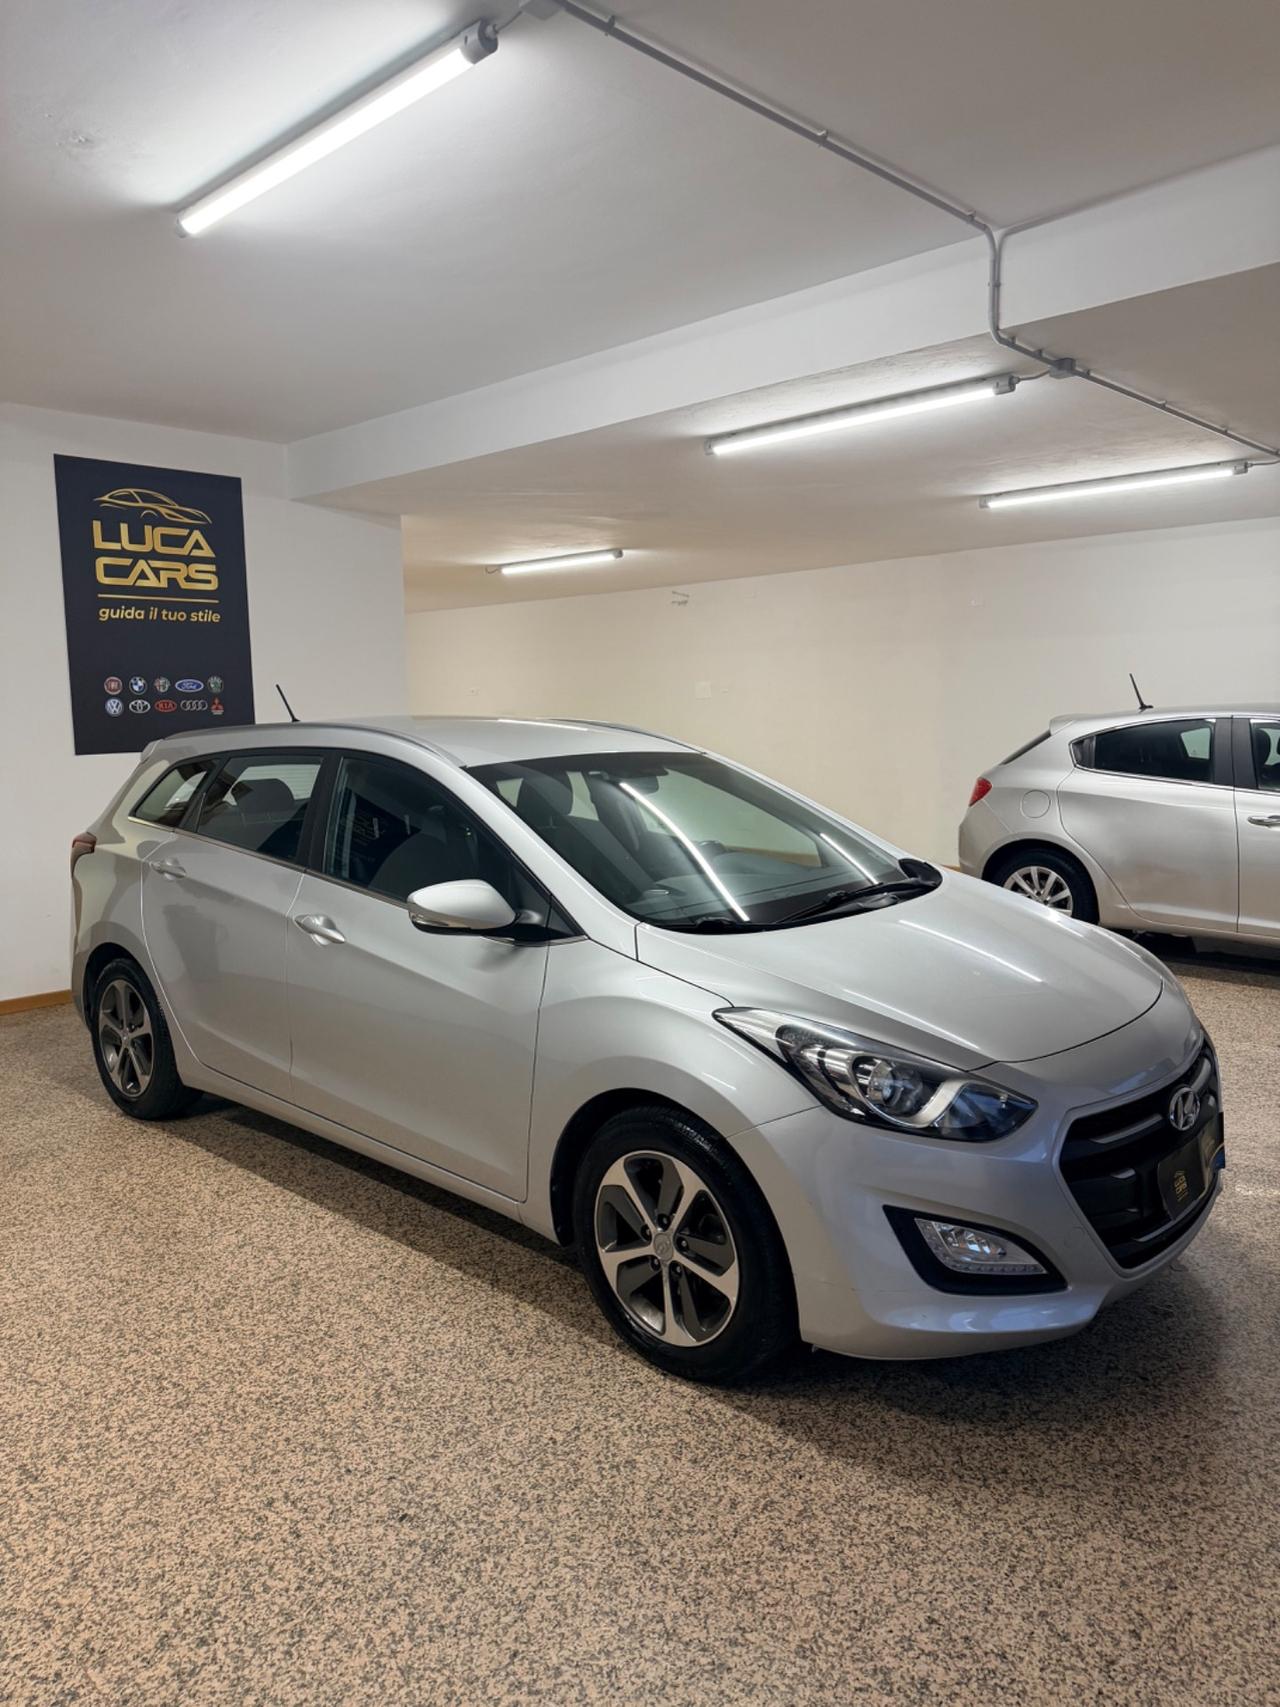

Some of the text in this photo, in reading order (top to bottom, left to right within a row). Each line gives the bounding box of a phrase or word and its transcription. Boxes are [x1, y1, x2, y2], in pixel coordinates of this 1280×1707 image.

[92, 519, 216, 557] LUCA
[95, 556, 219, 591] CARS
[98, 605, 221, 622] guida il tuo stile
